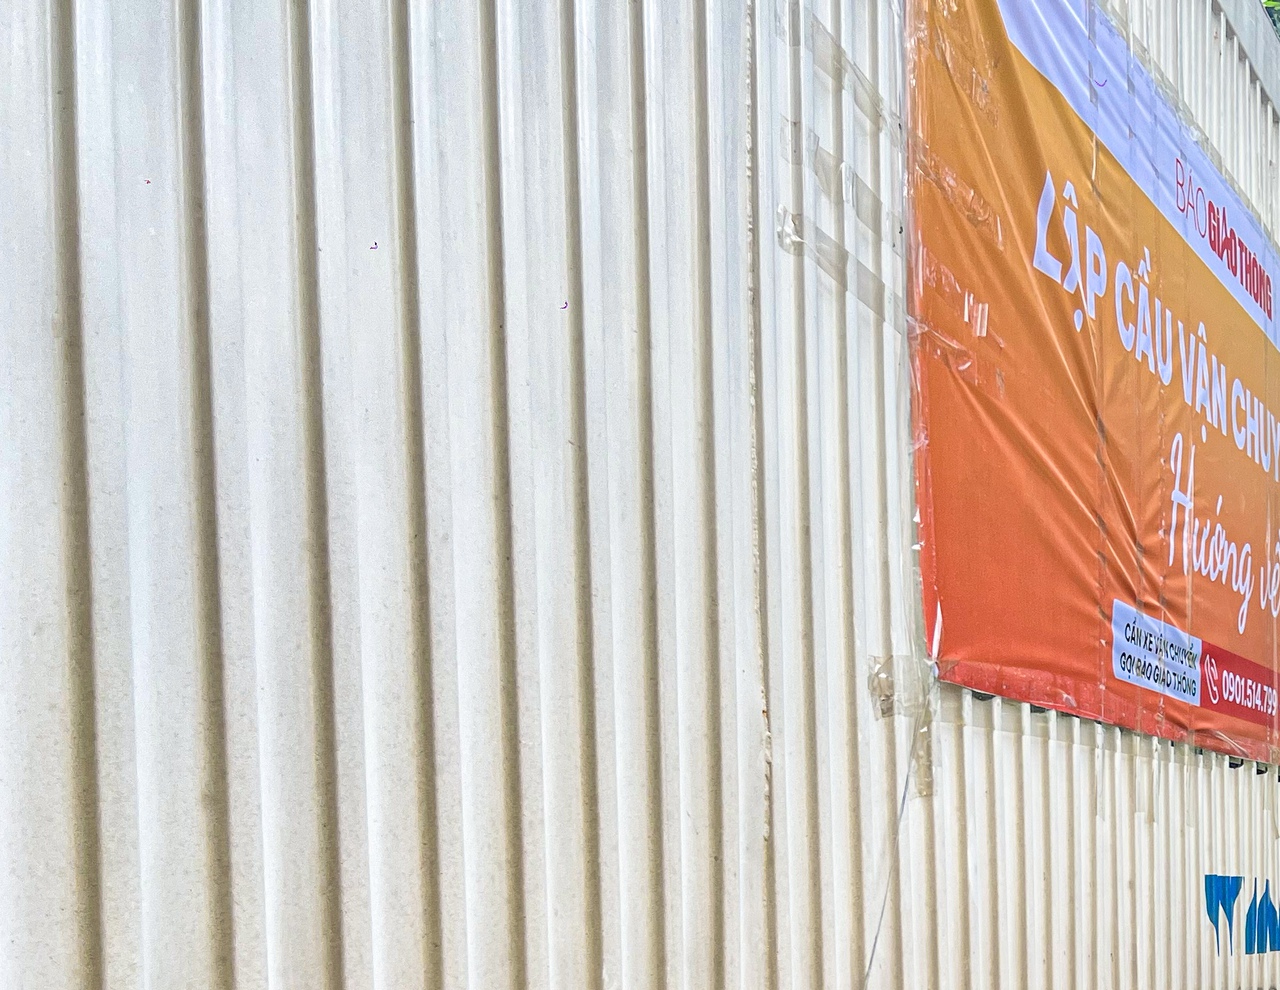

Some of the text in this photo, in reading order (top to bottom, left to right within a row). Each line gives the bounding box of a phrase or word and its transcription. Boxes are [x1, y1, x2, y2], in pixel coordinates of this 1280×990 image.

[1032, 170, 1108, 333] LẬP
[1114, 245, 1173, 386] CẦU
[1177, 321, 1228, 443] VẬN
[1168, 432, 1255, 635] Hướng
[1142, 630, 1154, 653] XE
[1119, 651, 1136, 680] GỌI
[1172, 671, 1197, 697] THÔNG
[1221, 669, 1278, 717] 0901.514.799
